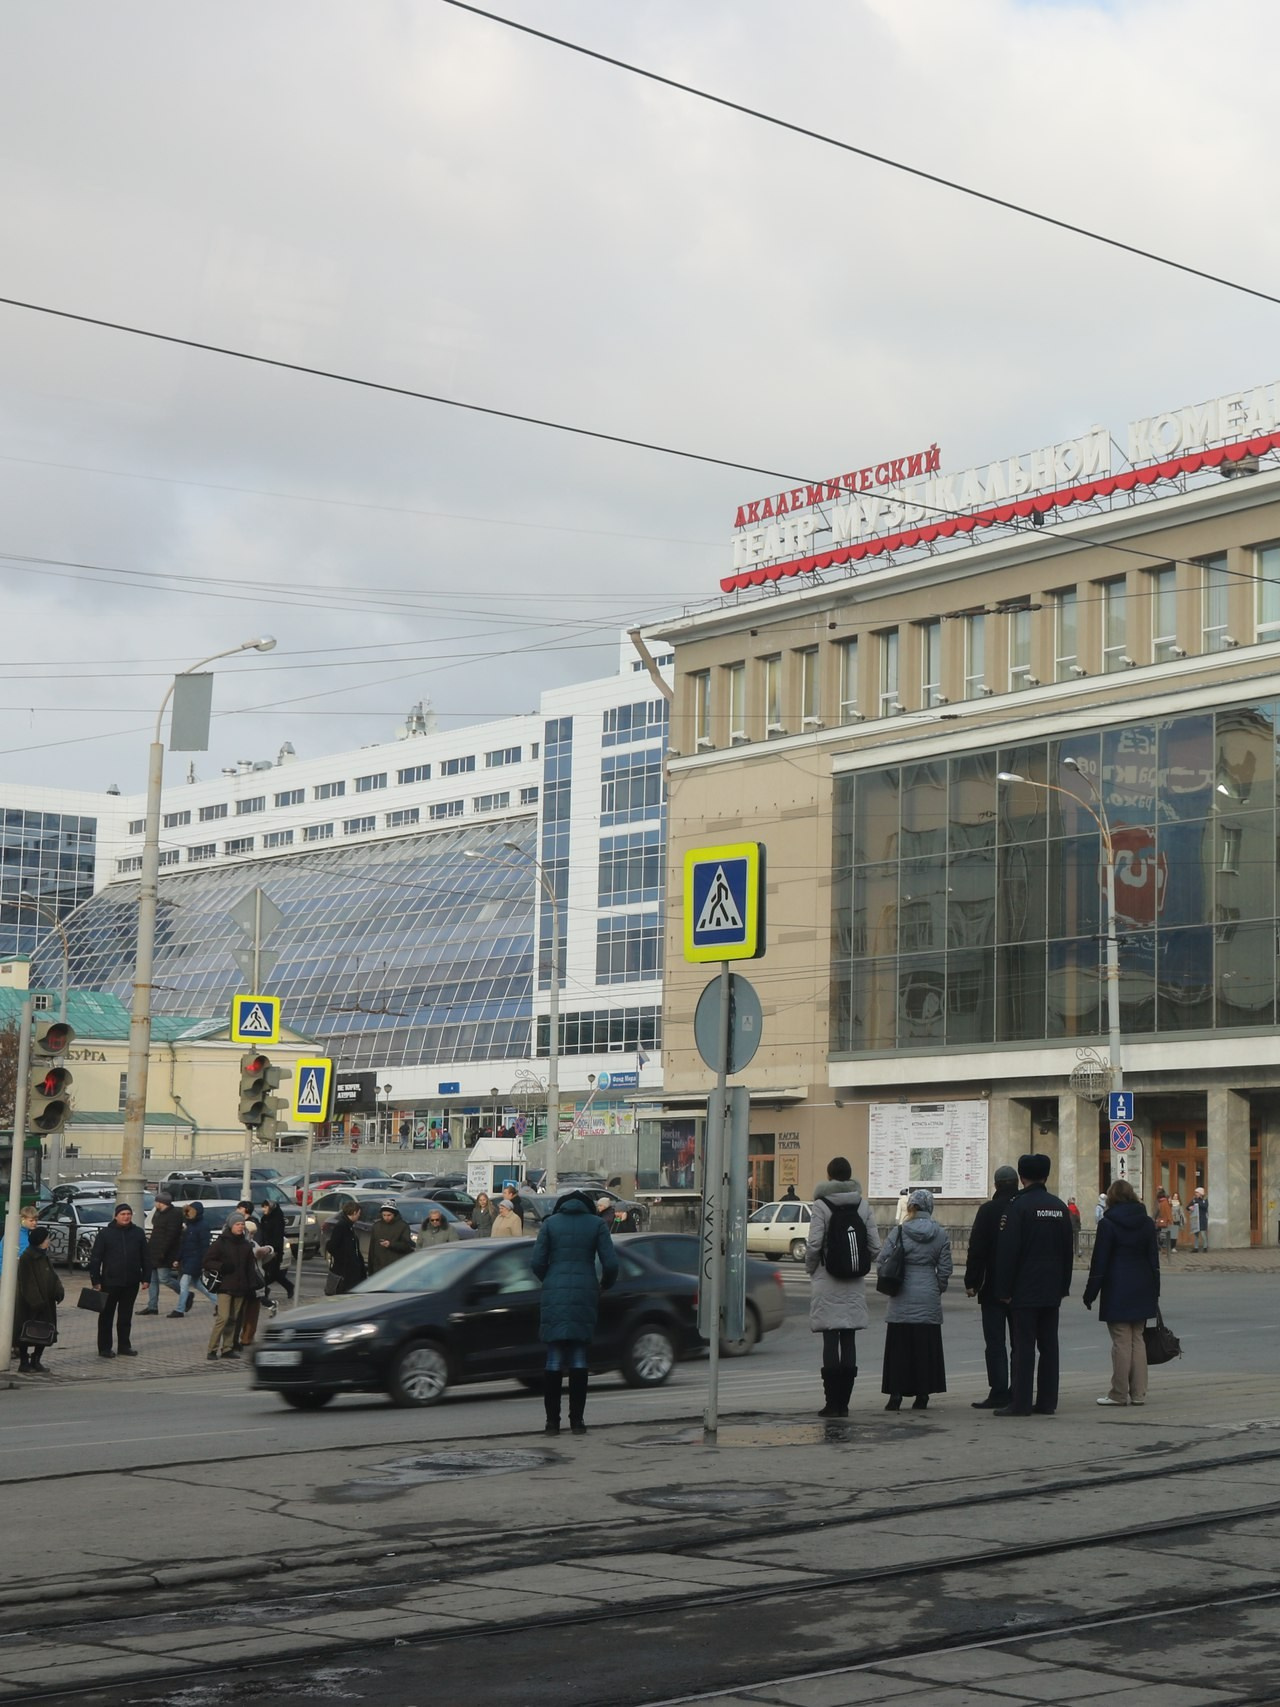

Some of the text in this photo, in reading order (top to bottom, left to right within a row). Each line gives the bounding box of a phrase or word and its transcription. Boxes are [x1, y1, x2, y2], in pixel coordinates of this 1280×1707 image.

[731, 513, 820, 569] ТЕАТР
[831, 424, 1112, 543] МУЗЫКАЛЬНОЙ
[734, 442, 942, 528] АКАДЕМИЧЕСКИЙ
[778, 1132, 800, 1140] КАССЫ
[778, 1141, 800, 1149] ТЕАТРА
